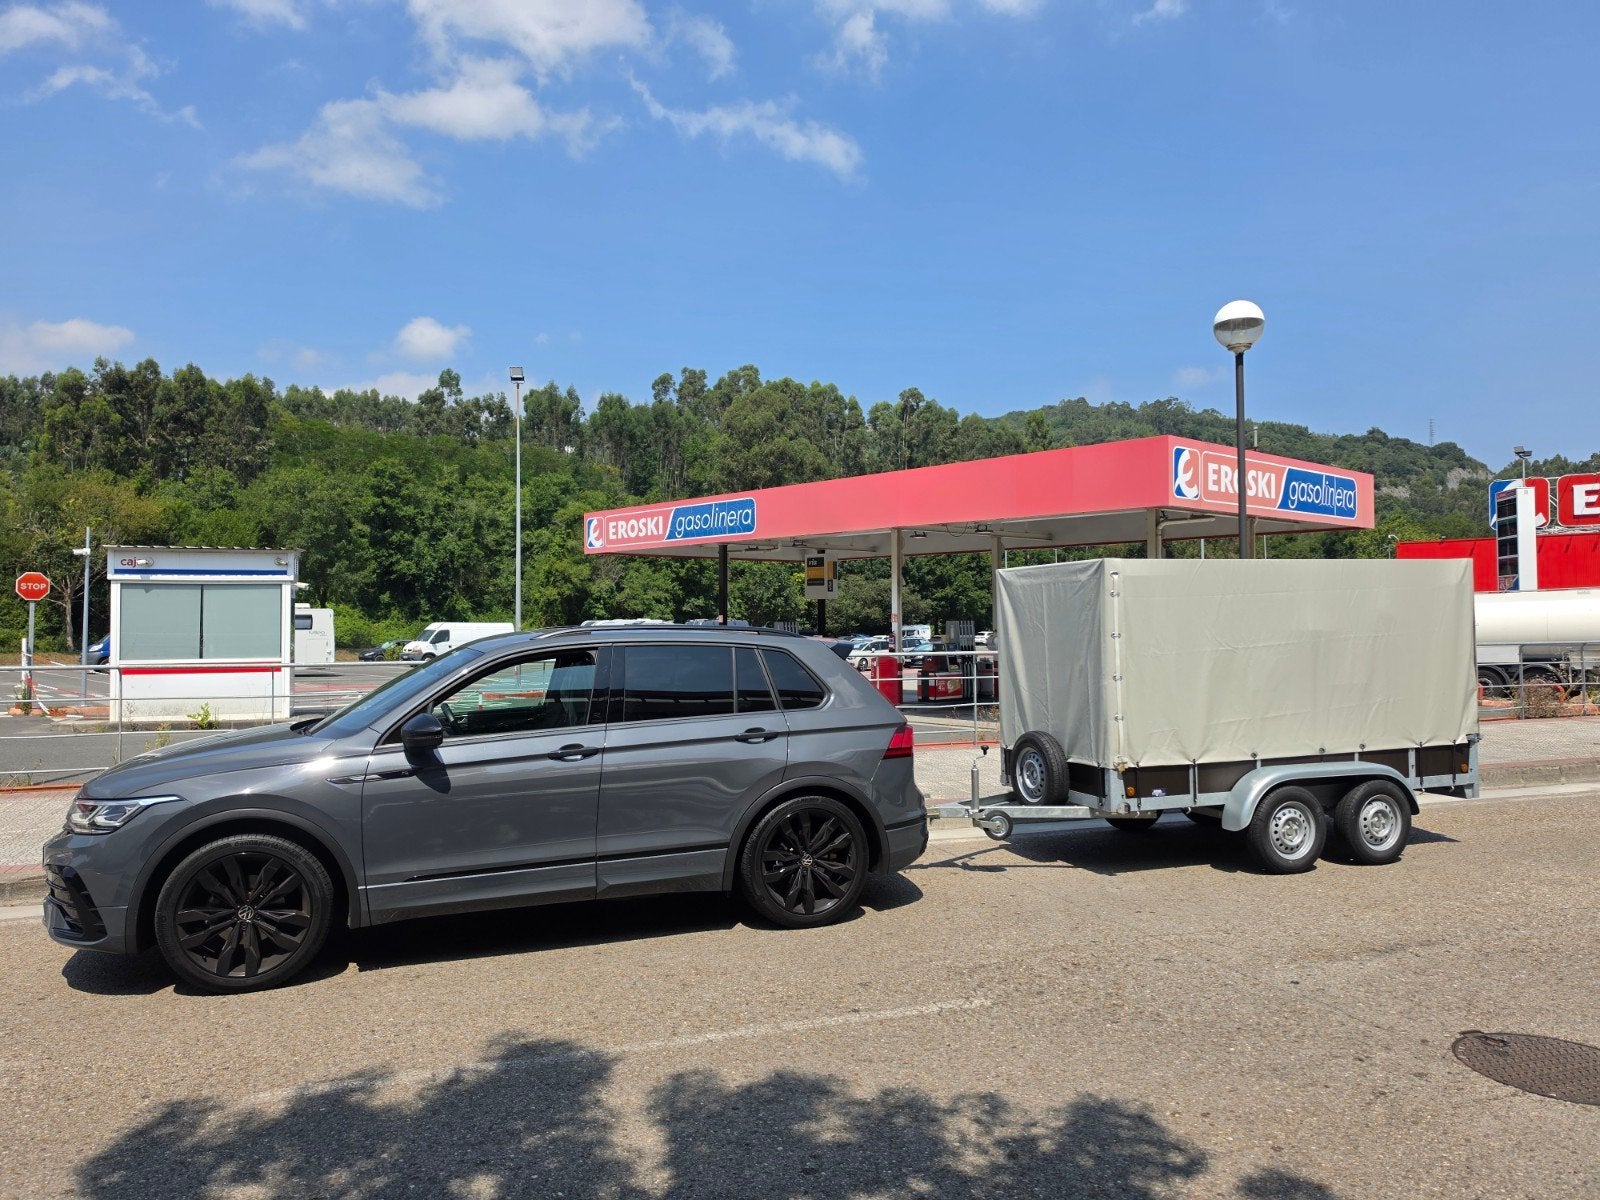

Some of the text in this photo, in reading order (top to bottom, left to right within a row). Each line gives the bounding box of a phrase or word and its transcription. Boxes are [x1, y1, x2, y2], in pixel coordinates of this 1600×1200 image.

[1288, 474, 1356, 510] gasolinera
[608, 504, 752, 540] EROSKI gasolinera
[20, 582, 47, 590] STOP
